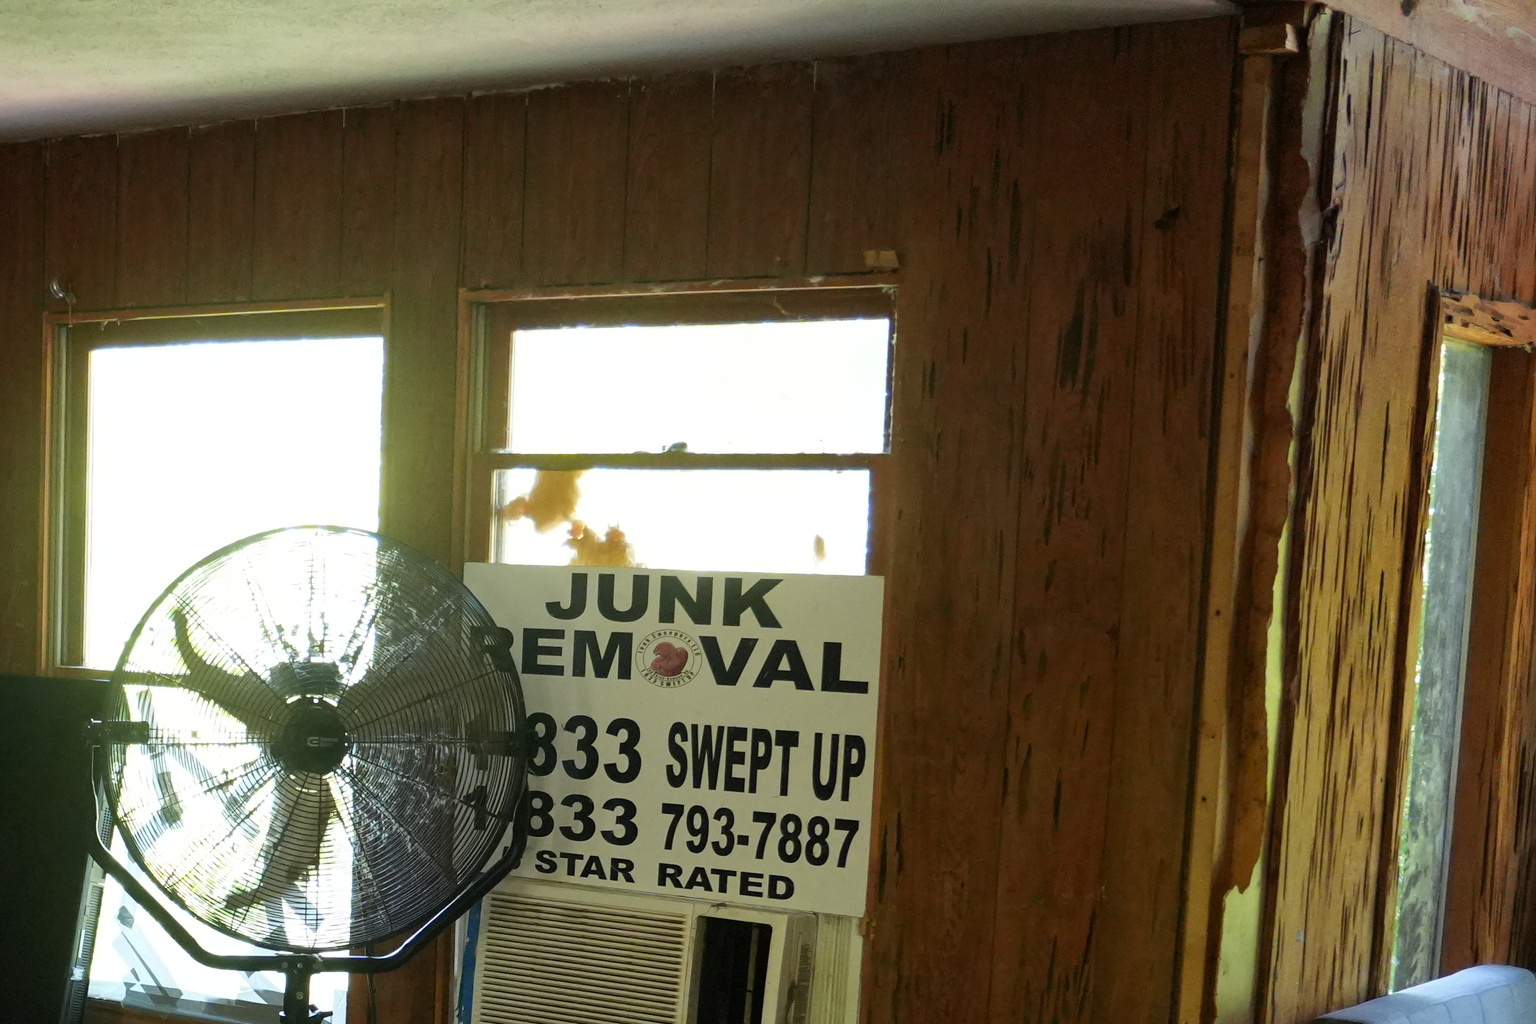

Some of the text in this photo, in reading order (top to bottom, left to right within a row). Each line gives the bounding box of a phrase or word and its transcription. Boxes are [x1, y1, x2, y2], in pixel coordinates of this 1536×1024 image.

[546, 573, 783, 629] JUNK
[524, 712, 642, 784] 833
[666, 721, 799, 797] SWEPT
[812, 732, 867, 802] UP
[525, 790, 639, 846] 833
[661, 802, 860, 869] 793-7887
[535, 849, 636, 884] STAR
[658, 862, 795, 900] RATED
